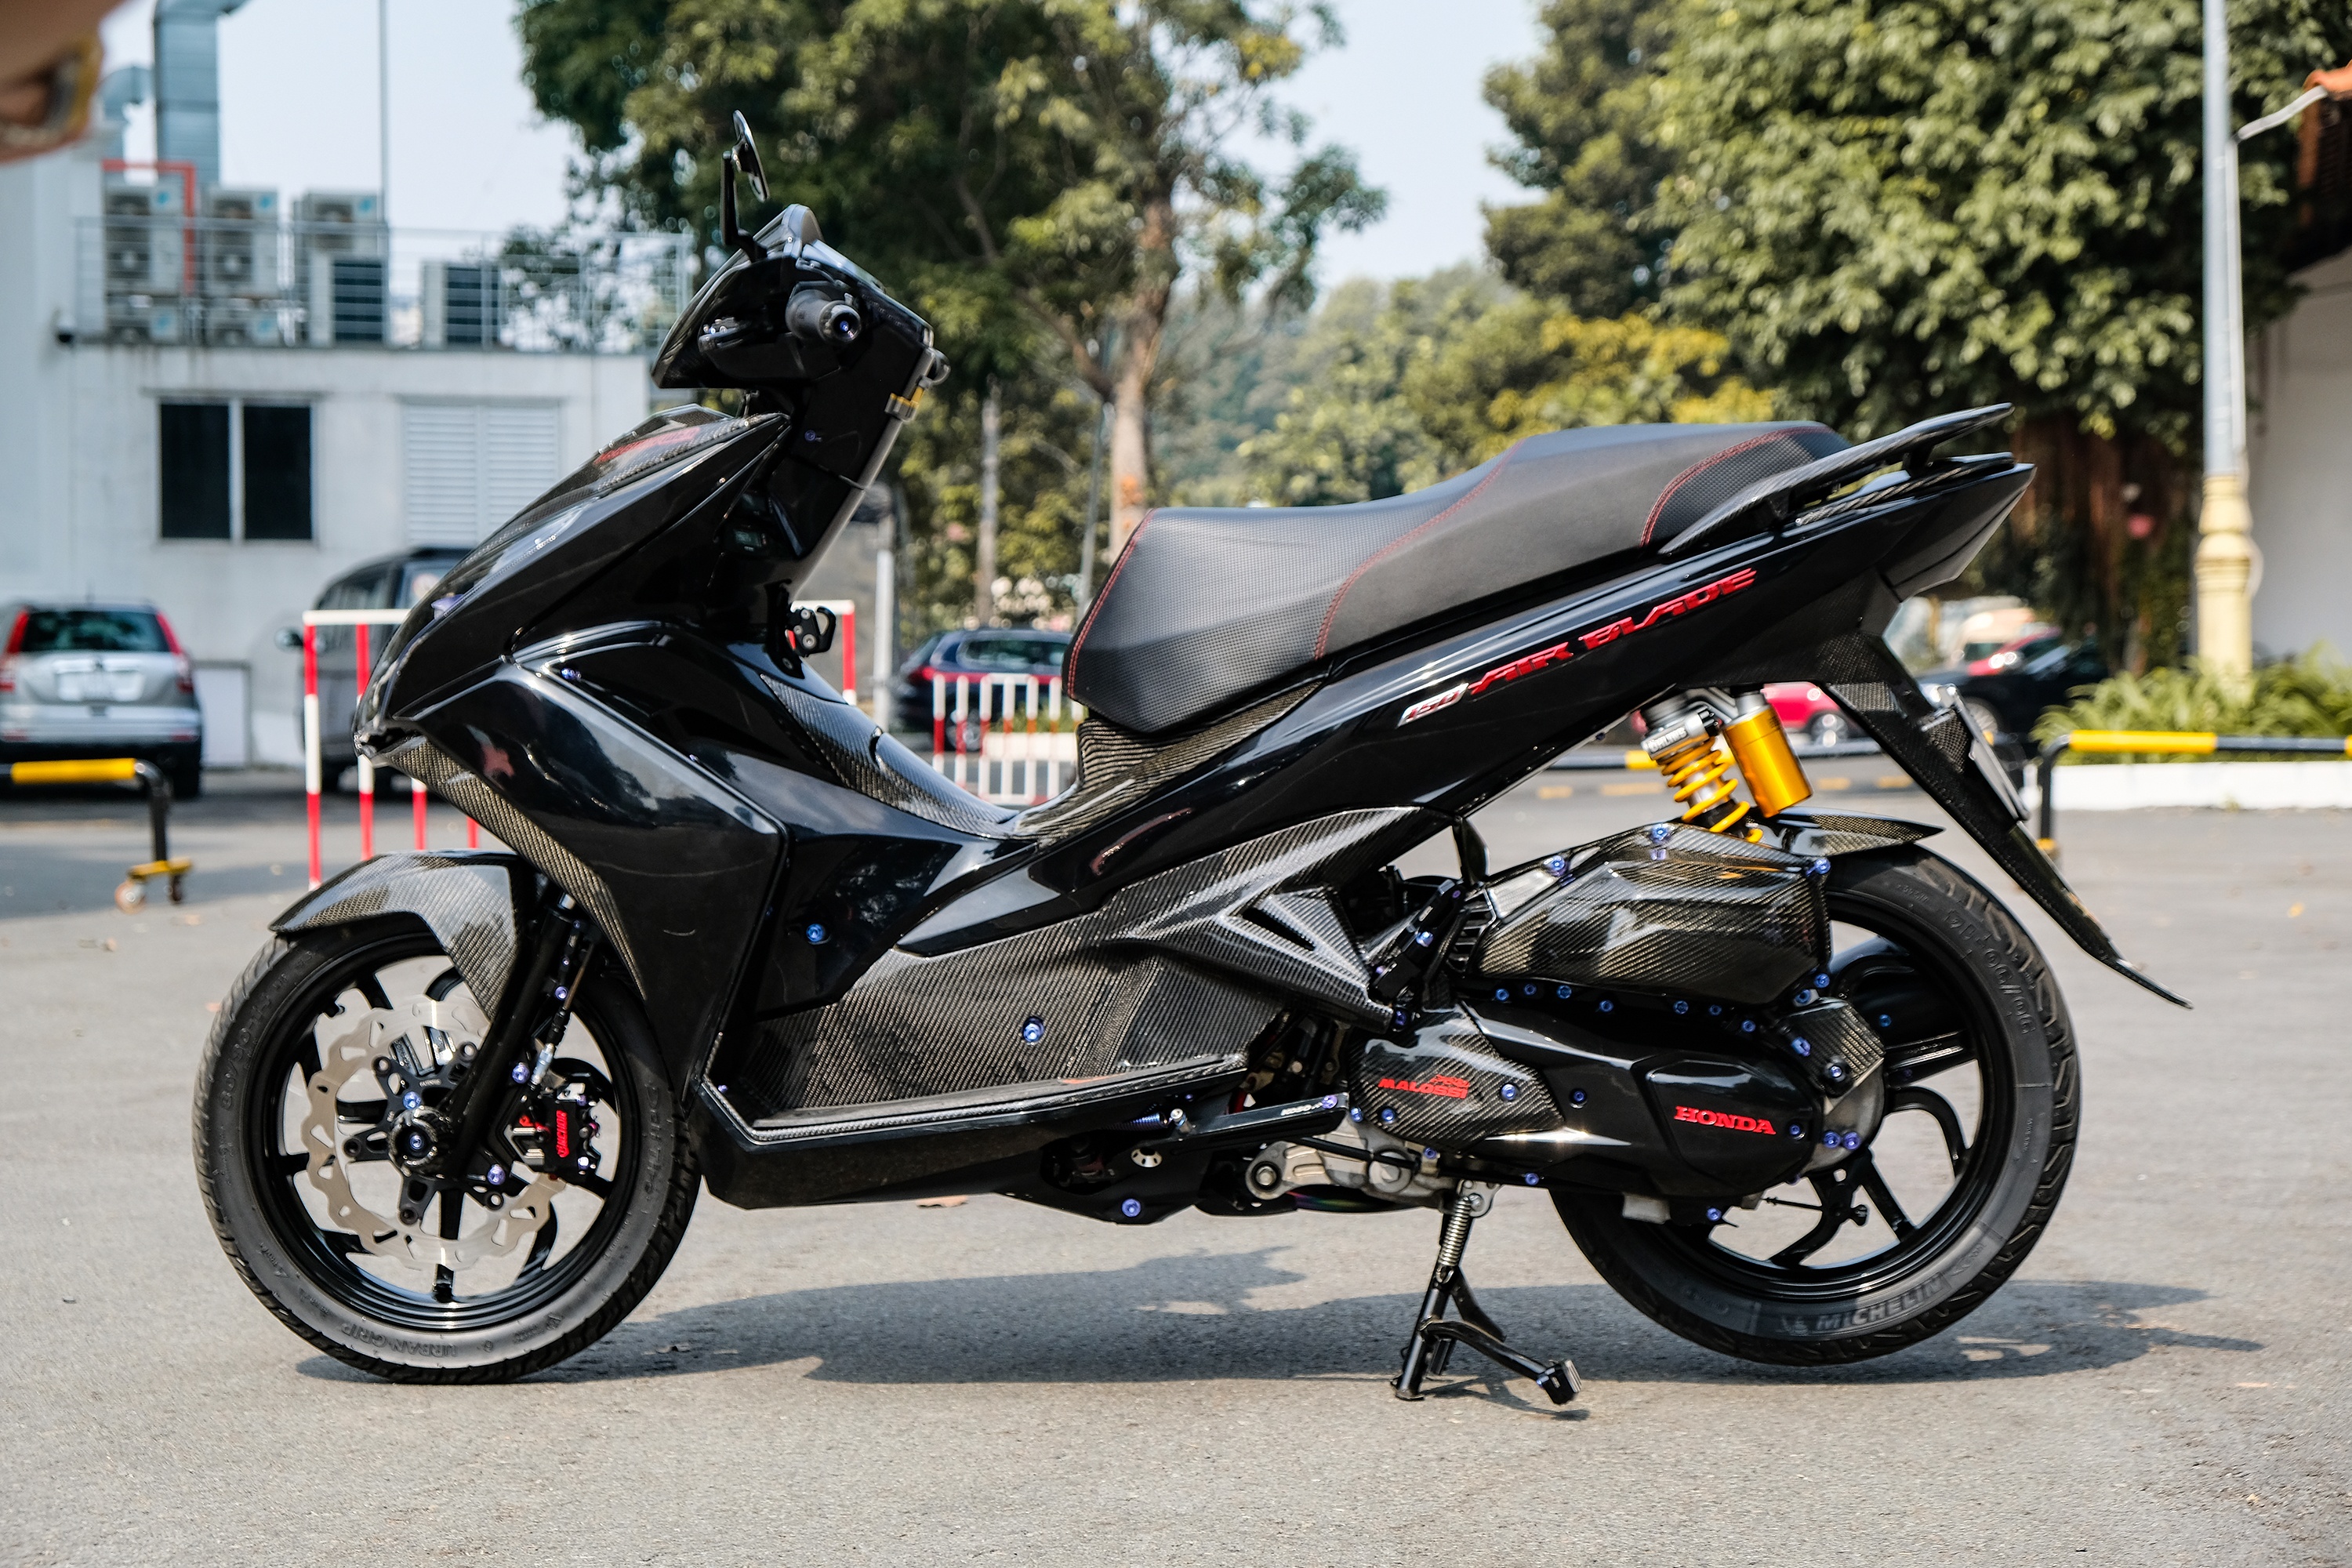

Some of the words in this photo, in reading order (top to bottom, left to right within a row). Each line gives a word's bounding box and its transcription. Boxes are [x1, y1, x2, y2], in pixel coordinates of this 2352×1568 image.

[1468, 641, 1573, 695] AIR
[1578, 568, 1757, 650] BLADE
[1377, 1077, 1468, 1099] MALOSSI
[1674, 1105, 1777, 1134] HONDA
[1816, 1275, 1944, 1330] MICHELIN
